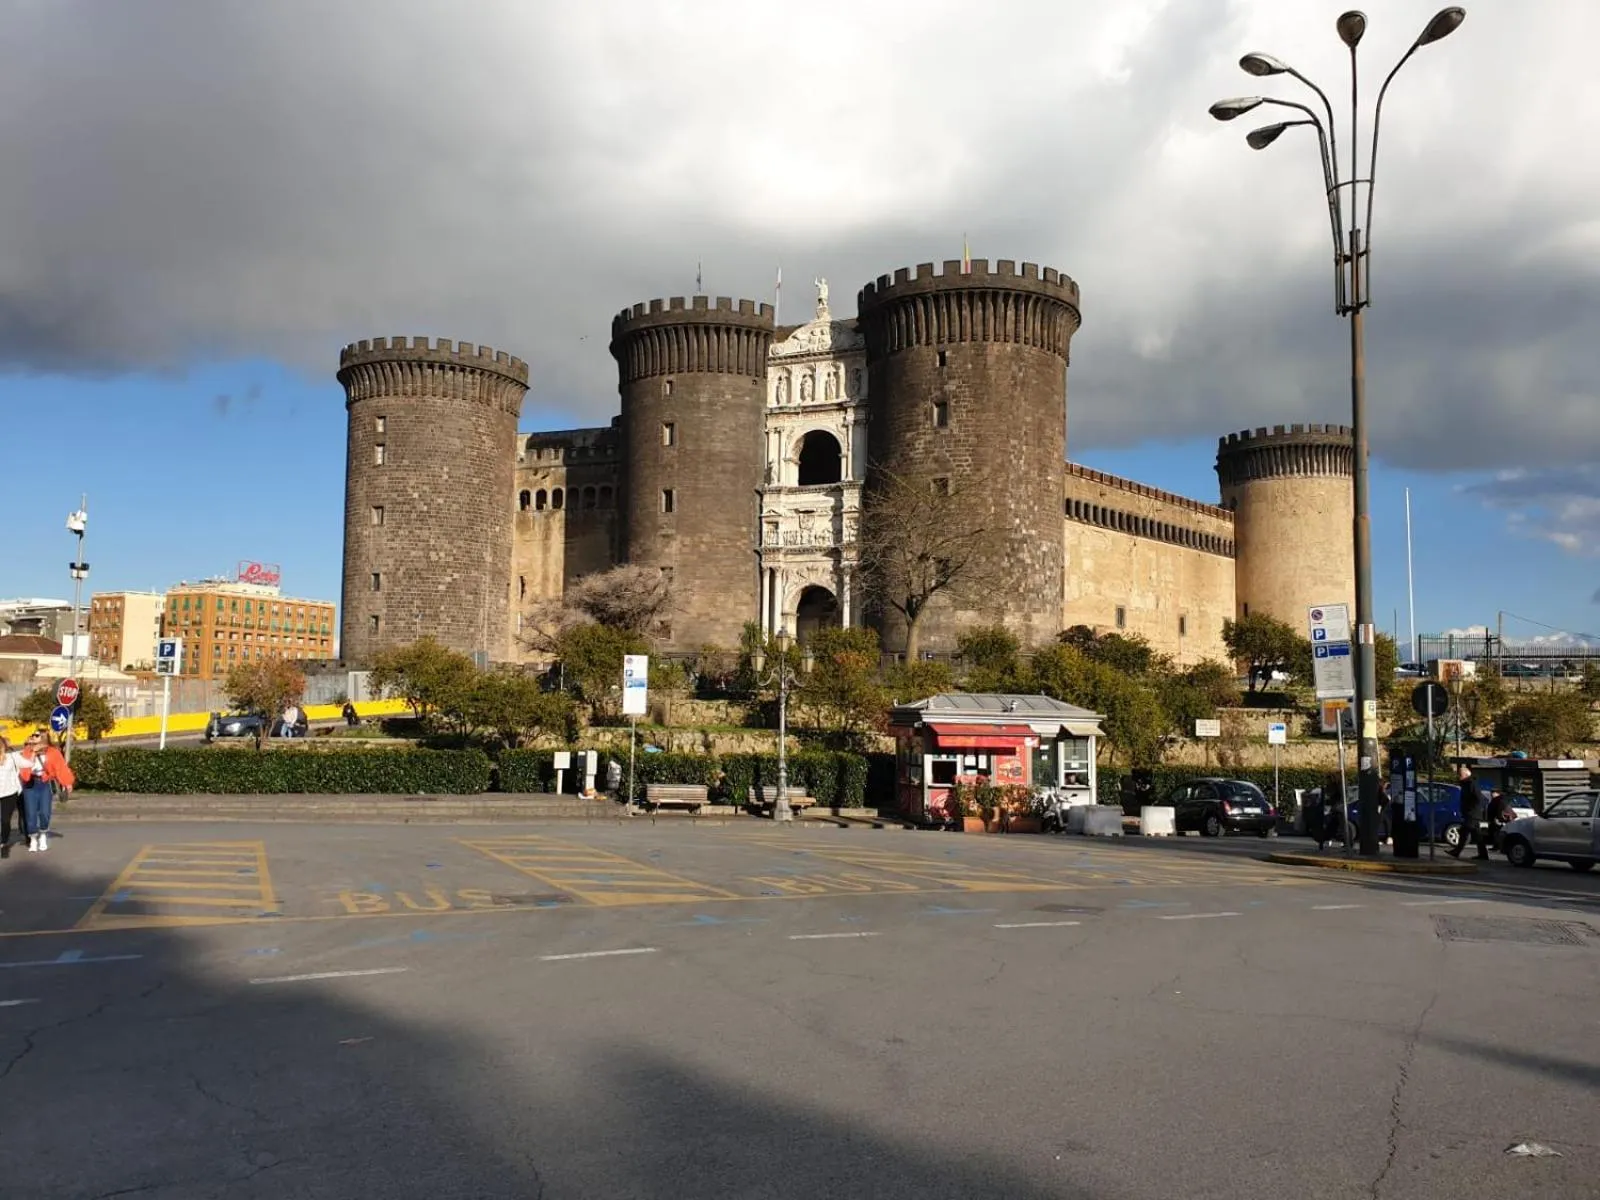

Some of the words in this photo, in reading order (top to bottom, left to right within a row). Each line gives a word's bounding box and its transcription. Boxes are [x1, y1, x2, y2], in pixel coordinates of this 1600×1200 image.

[163, 644, 171, 655] P
[60, 686, 77, 698] STOP
[338, 886, 510, 913] BUS
